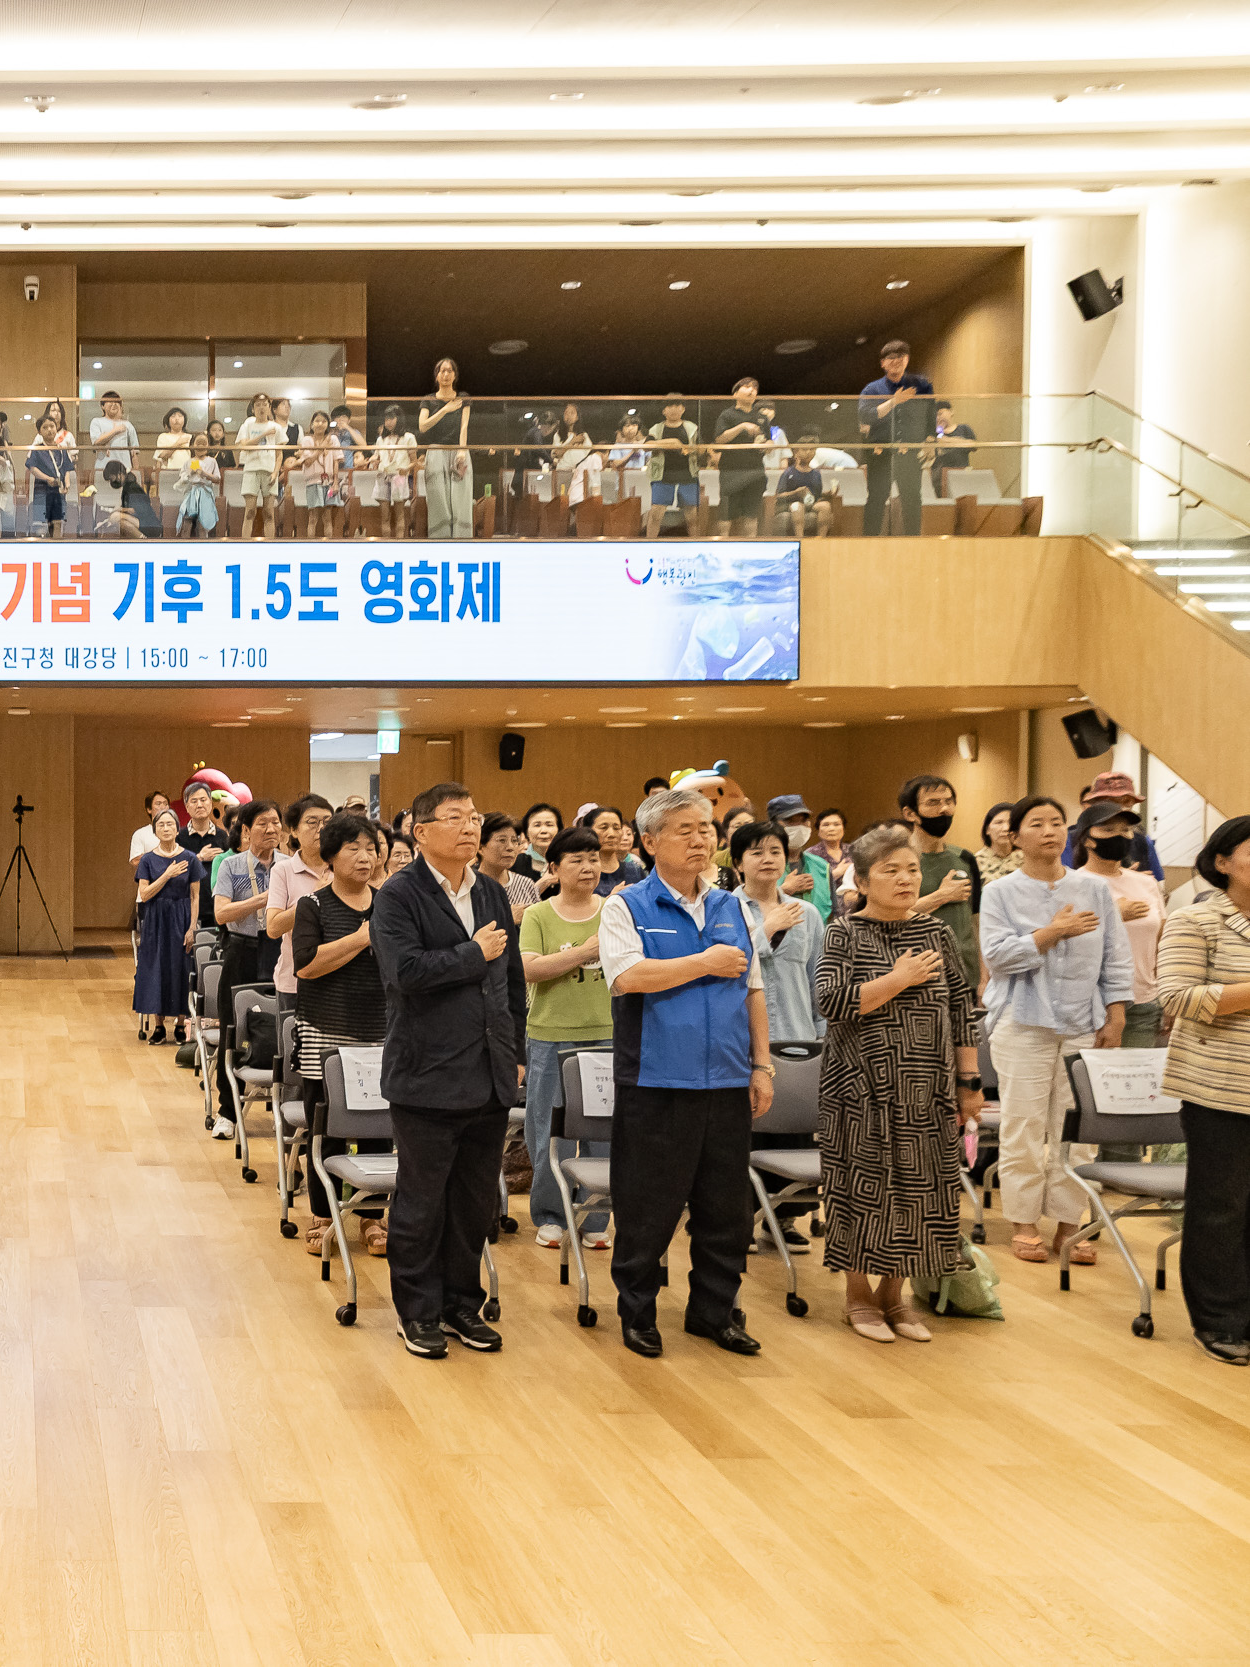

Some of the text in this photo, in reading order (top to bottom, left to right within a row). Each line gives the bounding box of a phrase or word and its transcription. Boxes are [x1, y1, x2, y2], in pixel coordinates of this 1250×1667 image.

[0, 561, 91, 623] 기념
[112, 559, 204, 624] 기후
[225, 562, 340, 622] 1.5도
[360, 559, 501, 625] 영화제
[64, 647, 117, 670] 대강당
[141, 647, 189, 668] 15:00
[219, 647, 268, 668] 17:00
